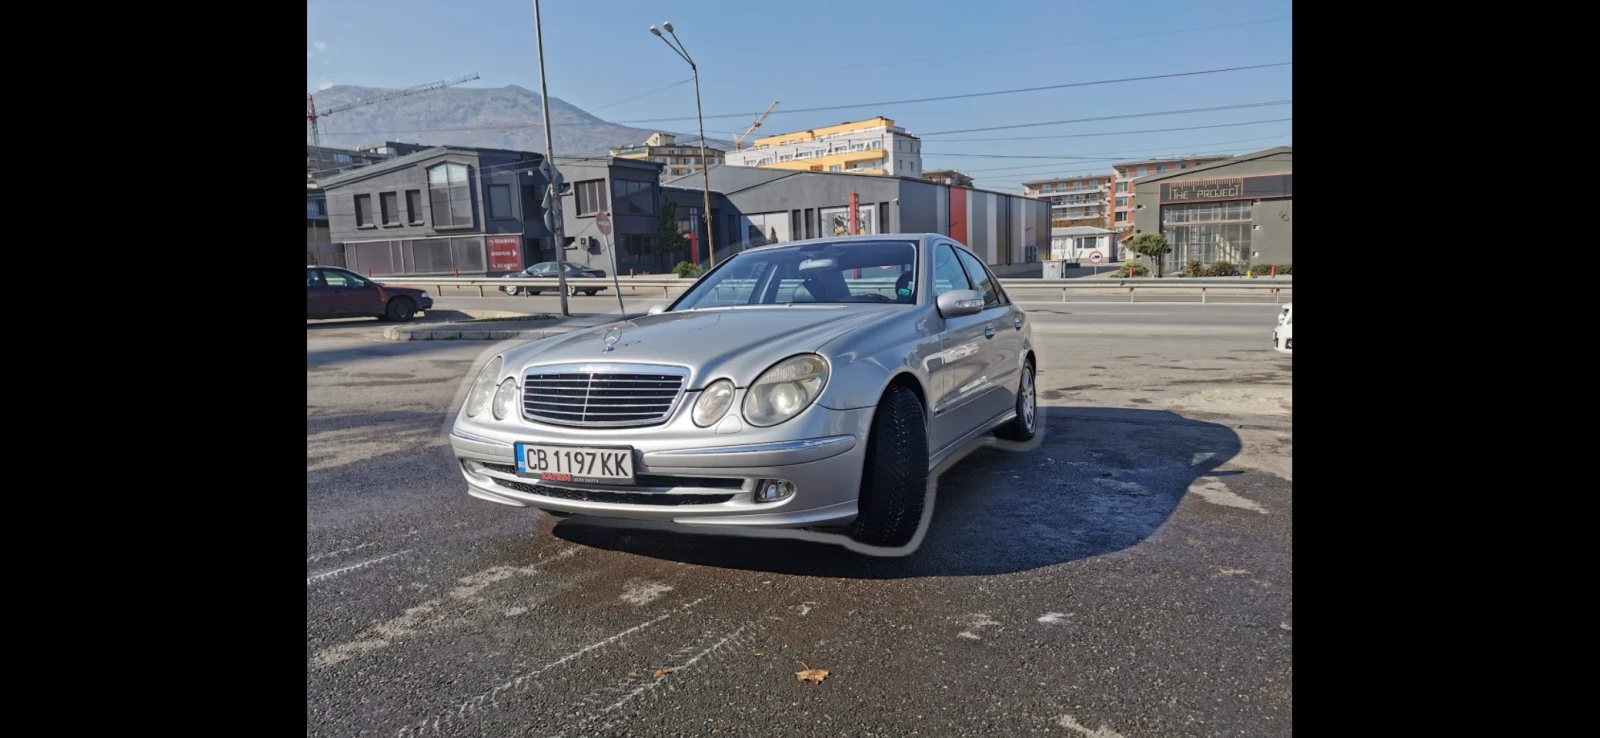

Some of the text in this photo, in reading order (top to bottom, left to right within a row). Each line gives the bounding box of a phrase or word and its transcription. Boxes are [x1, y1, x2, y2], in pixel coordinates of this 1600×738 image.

[1172, 185, 1240, 200] THE PROJECT
[527, 449, 628, 476] CB 1197 KK
